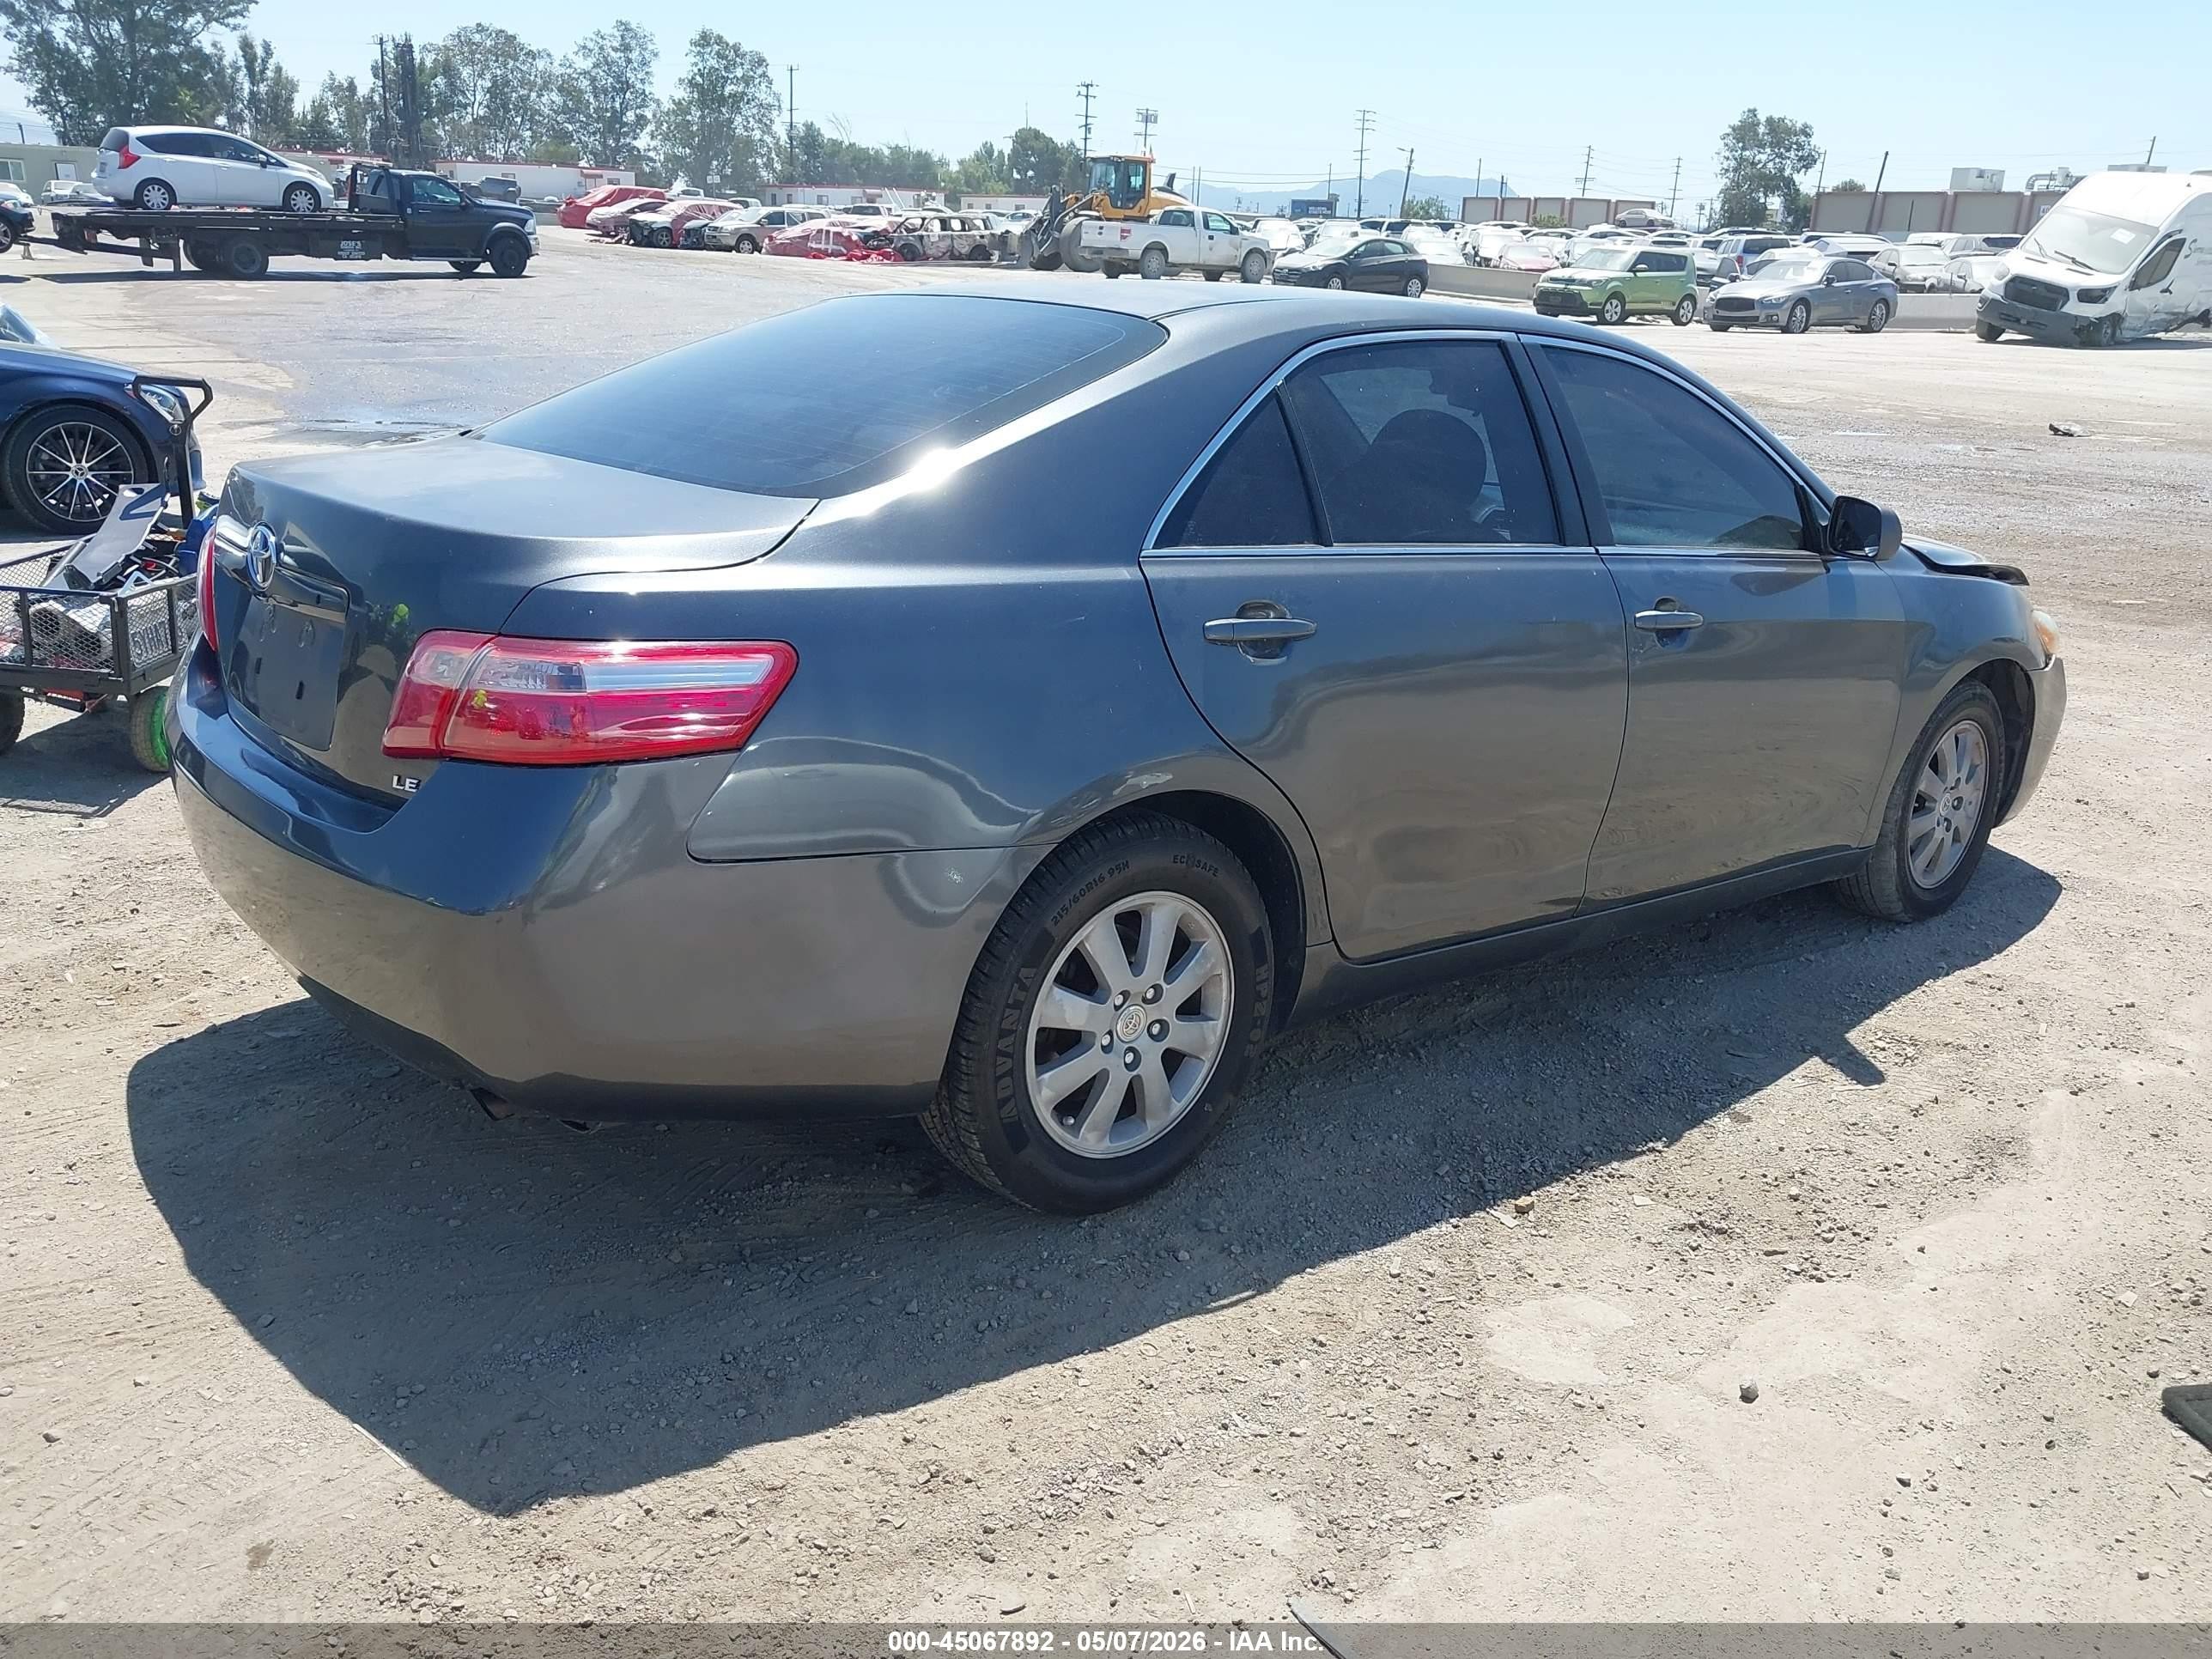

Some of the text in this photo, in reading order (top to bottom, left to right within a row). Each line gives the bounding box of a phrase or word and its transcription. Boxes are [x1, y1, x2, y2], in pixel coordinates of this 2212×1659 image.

[392, 775, 421, 793] LE
[1050, 860, 1130, 927] 215/60R16 95H
[995, 967, 1037, 1123] ADVANTA
